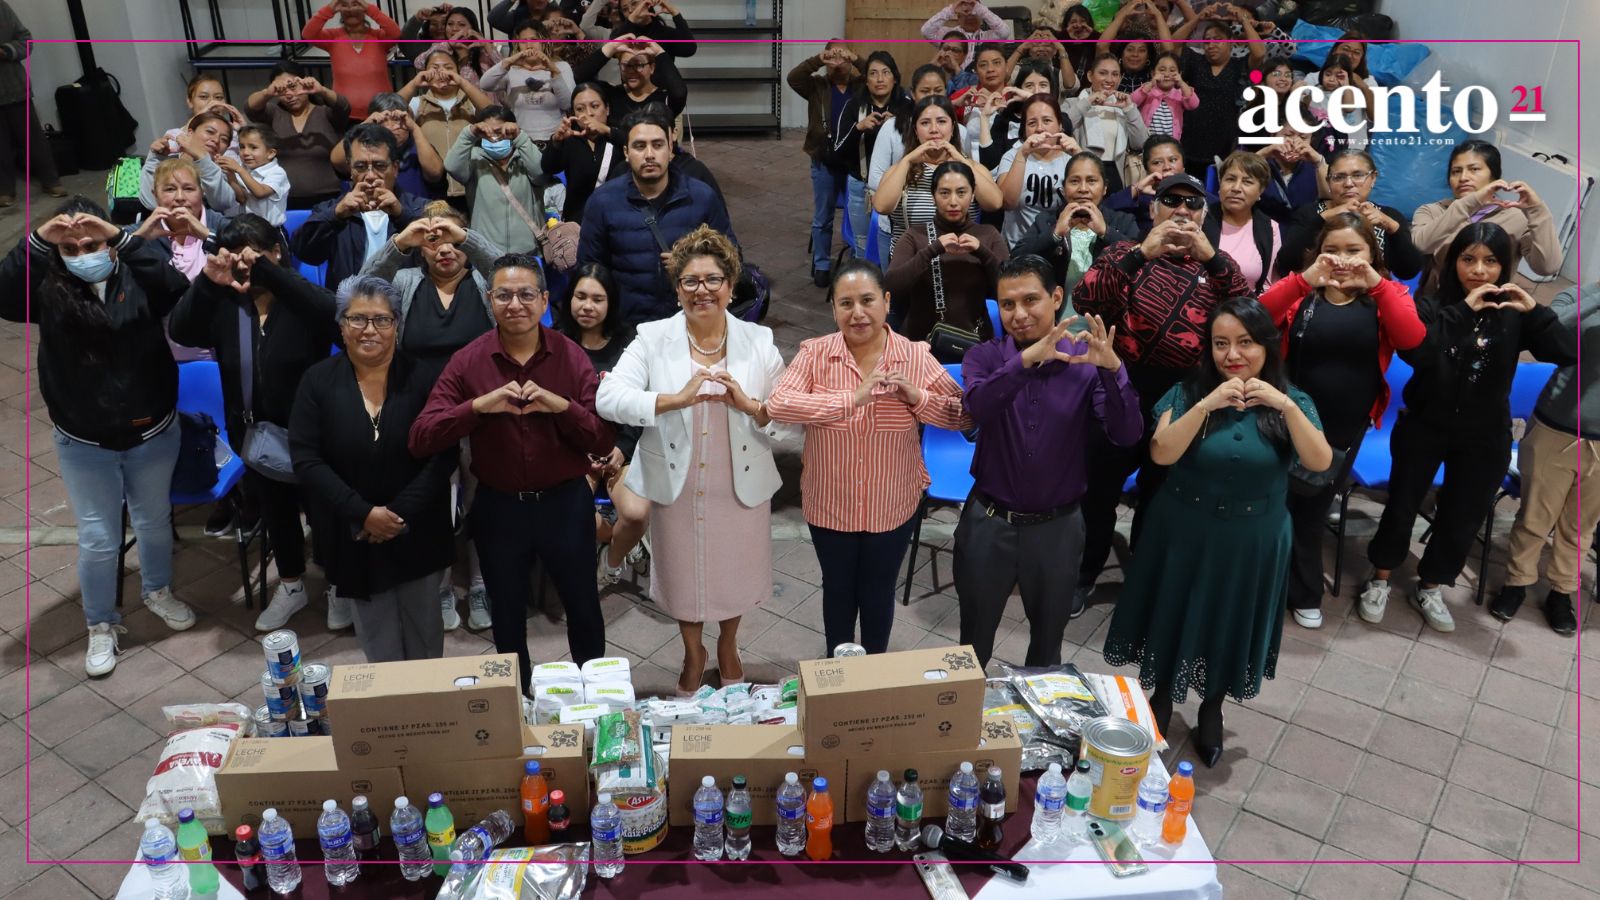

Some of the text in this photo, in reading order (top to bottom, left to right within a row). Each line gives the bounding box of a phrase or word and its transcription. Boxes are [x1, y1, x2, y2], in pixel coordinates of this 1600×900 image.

[343, 672, 376, 682] LECHE
[814, 668, 844, 677] LECHE
[833, 717, 869, 728] CONTIENE
[360, 725, 399, 734] CONTIENE
[235, 747, 266, 756] LECHE
